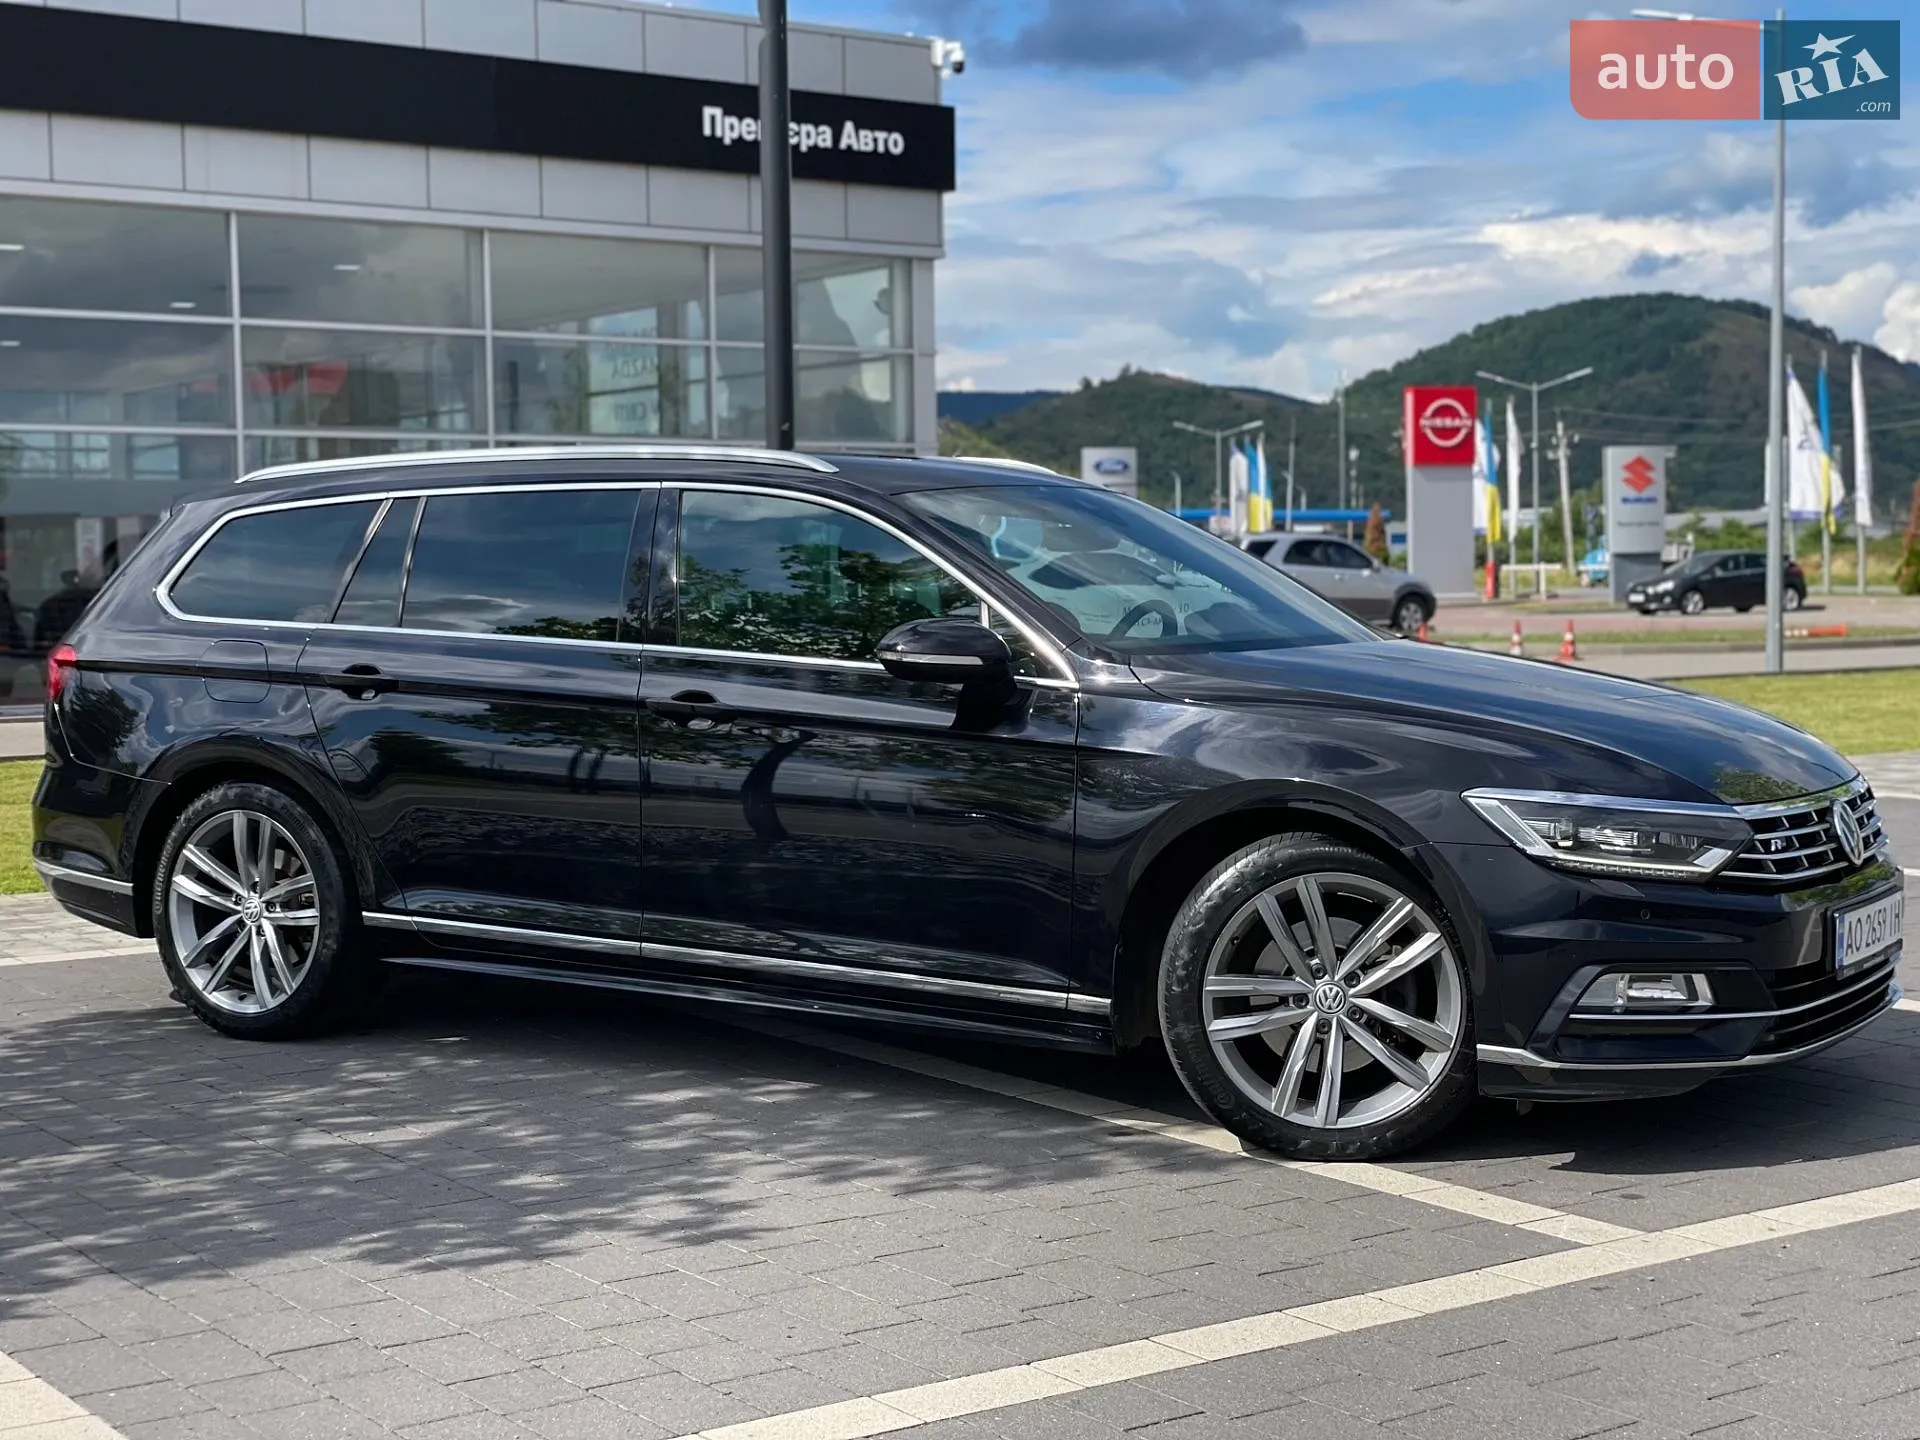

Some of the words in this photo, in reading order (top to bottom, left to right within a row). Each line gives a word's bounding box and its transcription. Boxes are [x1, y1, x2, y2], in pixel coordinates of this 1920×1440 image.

[702, 105, 833, 153] Преєра
[838, 119, 905, 156] Авто
[1845, 917, 1863, 957] AO
[1865, 906, 1887, 949] 2659
